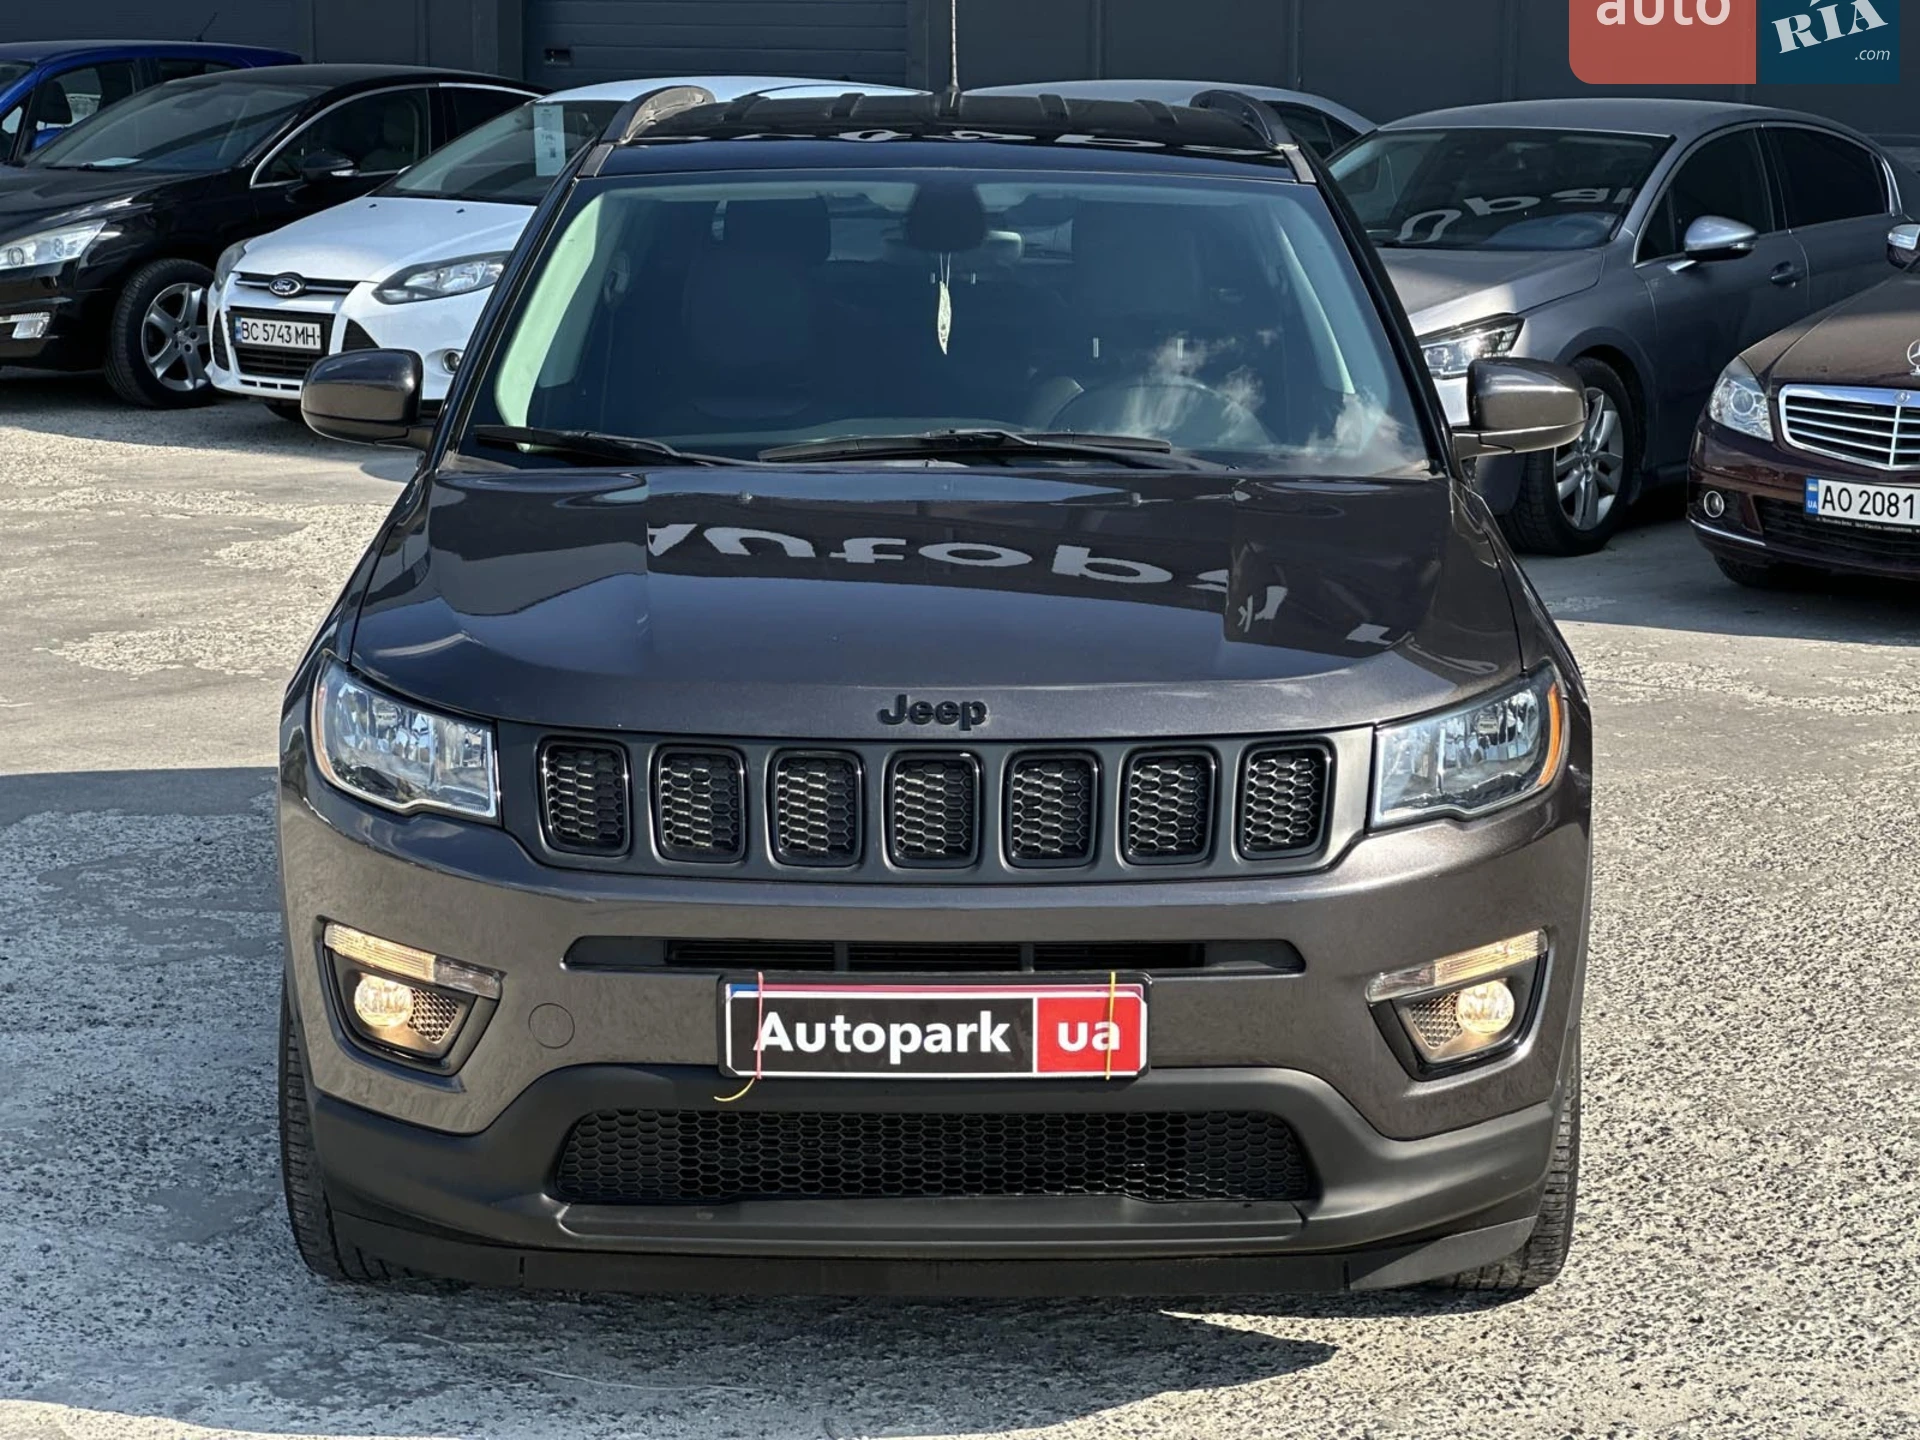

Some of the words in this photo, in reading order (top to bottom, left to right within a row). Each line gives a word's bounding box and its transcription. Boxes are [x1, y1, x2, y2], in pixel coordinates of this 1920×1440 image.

[241, 321, 259, 341] BC
[262, 323, 293, 344] 5743
[295, 325, 317, 346] MH
[1807, 500, 1818, 509] UA
[1822, 485, 1852, 512] AO
[1858, 489, 1914, 519] 2081
[877, 693, 989, 732] Jeep
[753, 1010, 1011, 1065] Autopark
[1056, 1020, 1121, 1051] ua
